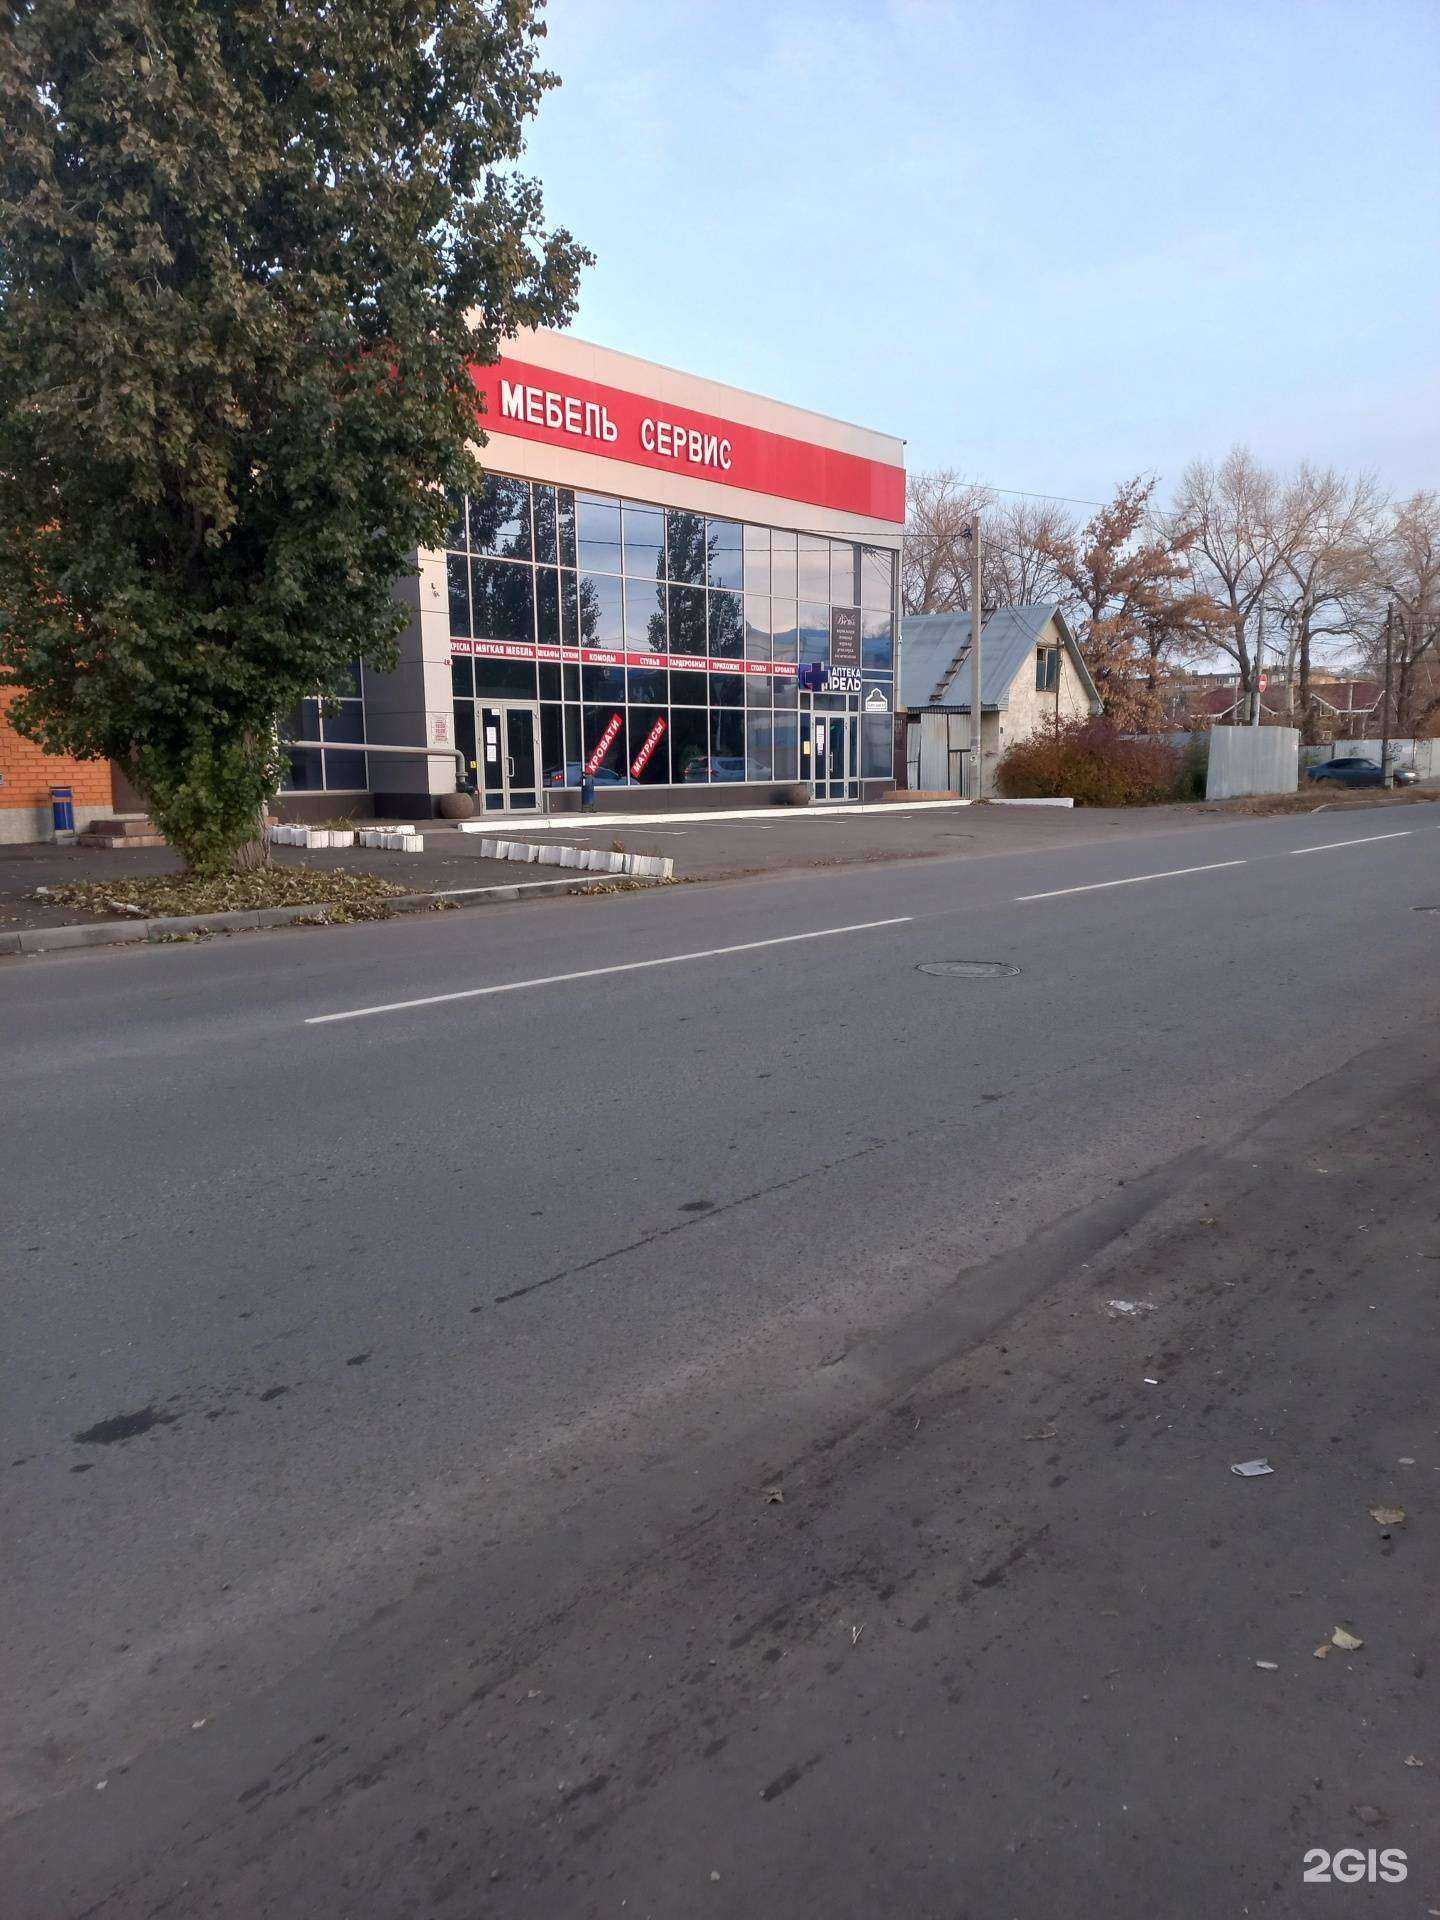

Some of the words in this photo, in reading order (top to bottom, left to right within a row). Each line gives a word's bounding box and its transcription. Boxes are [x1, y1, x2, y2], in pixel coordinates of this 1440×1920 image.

[500, 379, 618, 443] МЕБЕЛЬ
[640, 417, 733, 470] СЕРВИС
[475, 643, 504, 655] МЯГКАЯ
[505, 645, 534, 657] МЕБЕЛЬ
[537, 649, 560, 658] ШКАФЫ
[589, 653, 617, 663] КОМОДЫ
[639, 657, 660, 666] СТУЛЬЯ
[750, 664, 767, 672] СТОЛЫ
[774, 666, 796, 674] КРОВАТИ
[831, 666, 861, 678] АПТЕКА
[588, 719, 620, 772] КРОВАТИ
[632, 721, 664, 774] МАТРАСЫ
